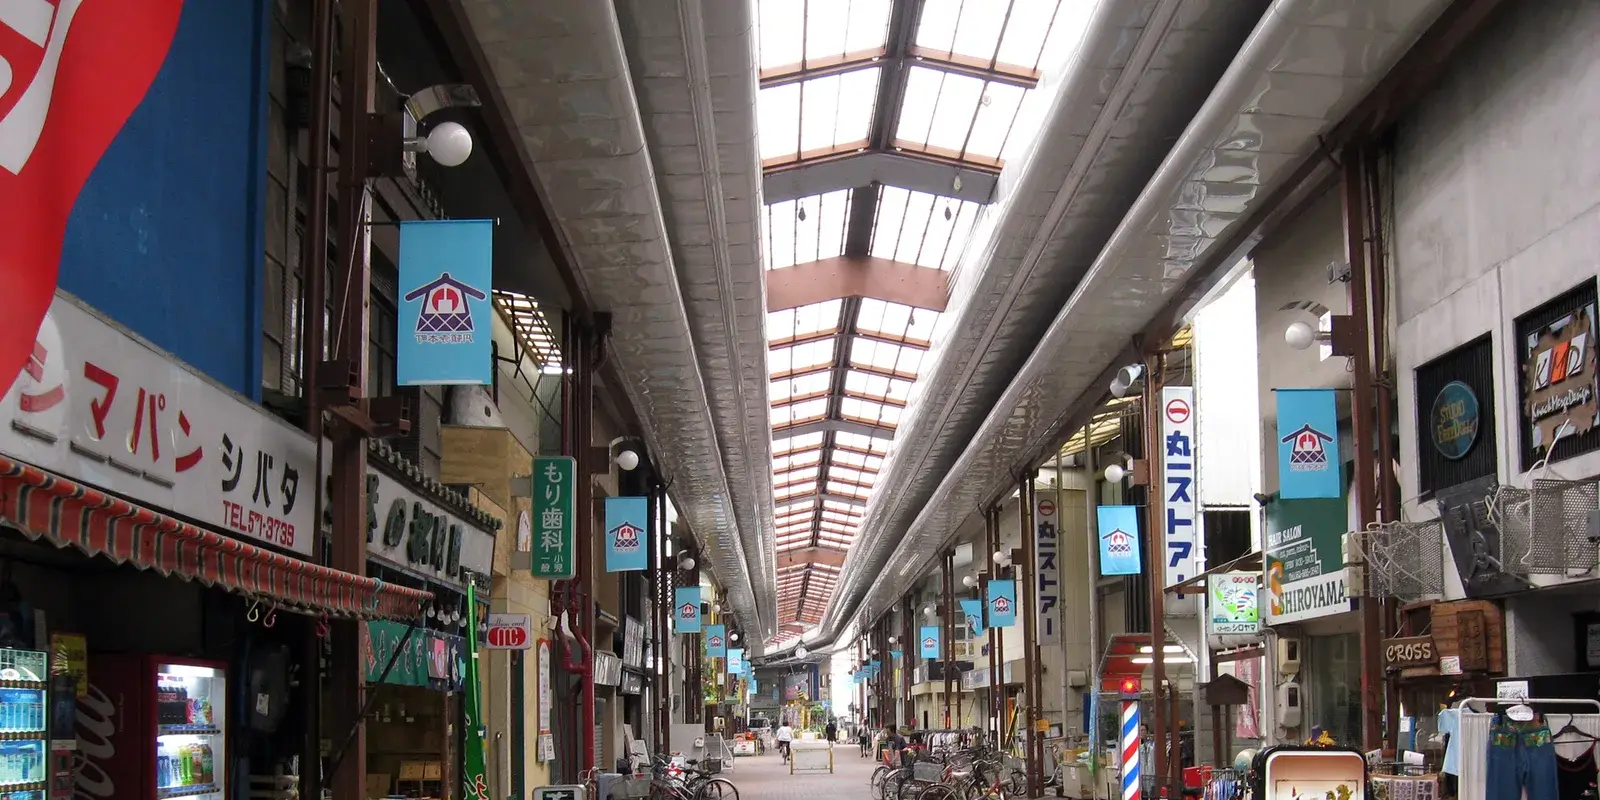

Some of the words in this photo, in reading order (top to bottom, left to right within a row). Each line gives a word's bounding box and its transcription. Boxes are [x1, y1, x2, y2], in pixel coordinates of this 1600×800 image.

[221, 432, 300, 516] シバタ
[540, 462, 564, 553] もり歯科
[1283, 524, 1302, 543] SALON
[1232, 624, 1256, 632] シロヤマ
[1386, 642, 1432, 662] CROSS
